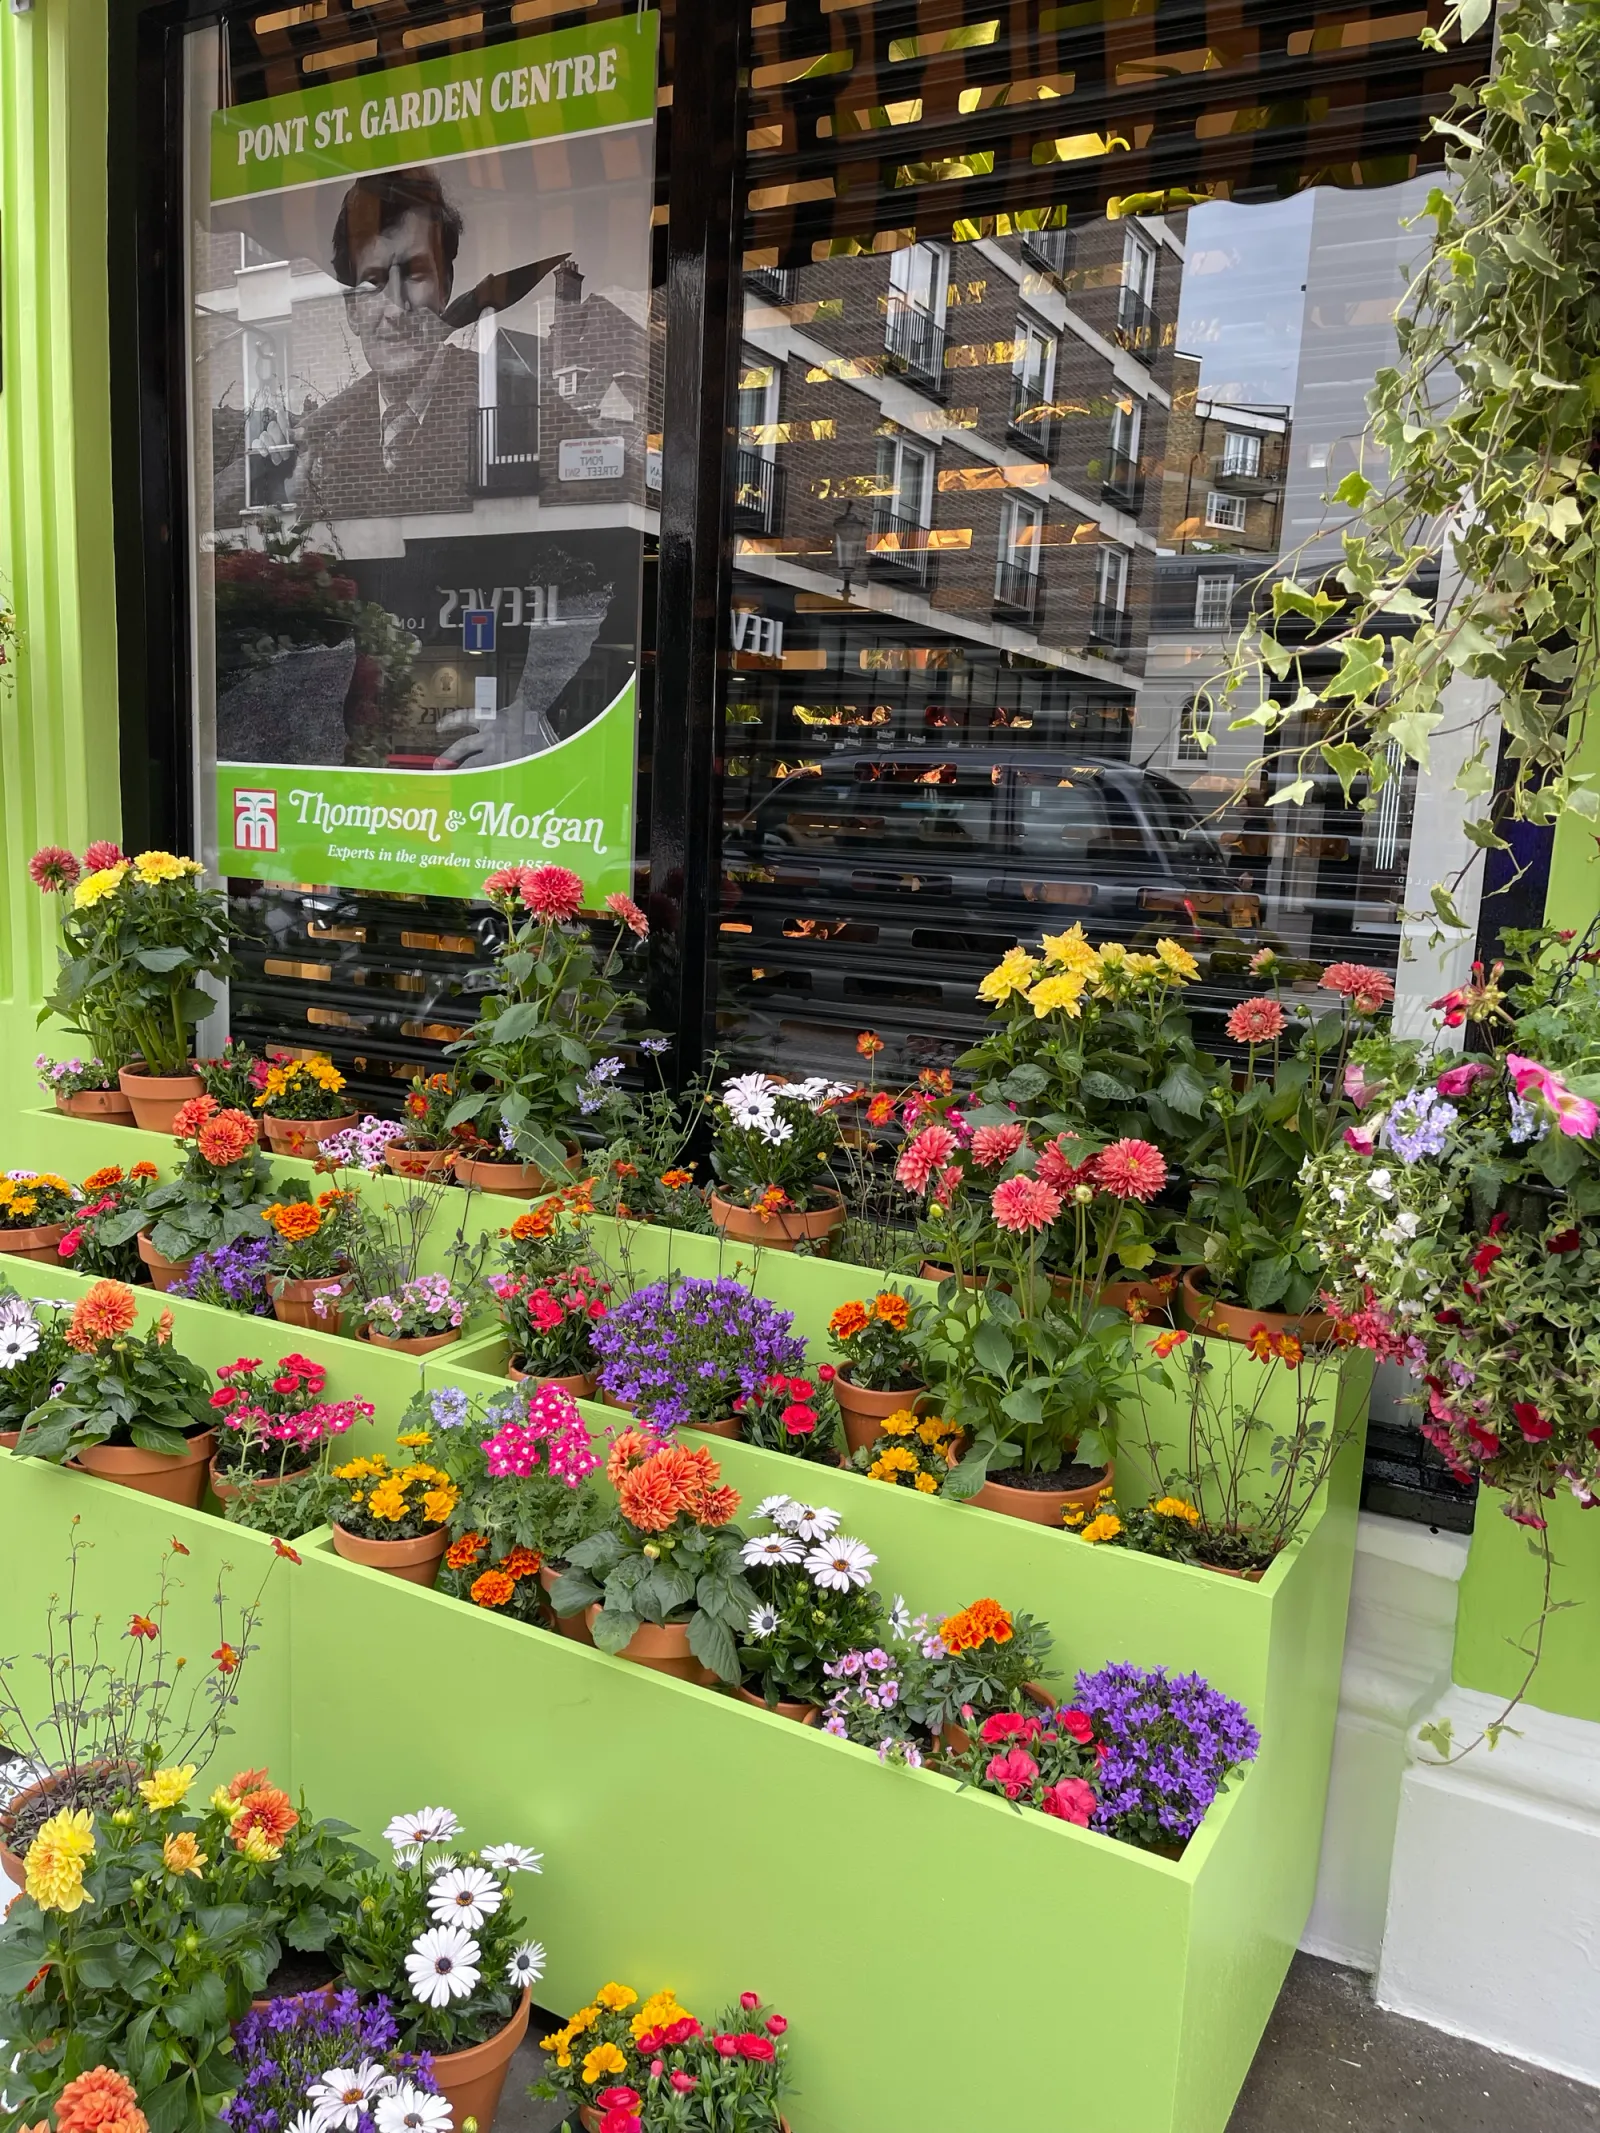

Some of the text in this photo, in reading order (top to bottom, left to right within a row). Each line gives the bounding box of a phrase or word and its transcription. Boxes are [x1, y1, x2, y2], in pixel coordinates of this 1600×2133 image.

[237, 48, 617, 165] PONT ST. GARDEN CENTRE
[289, 789, 607, 854] Thompson & Morgan
[327, 844, 375, 861] Experts
[378, 851, 393, 862] in
[395, 850, 416, 863] the
[419, 852, 471, 868] garden
[474, 856, 512, 870] since
